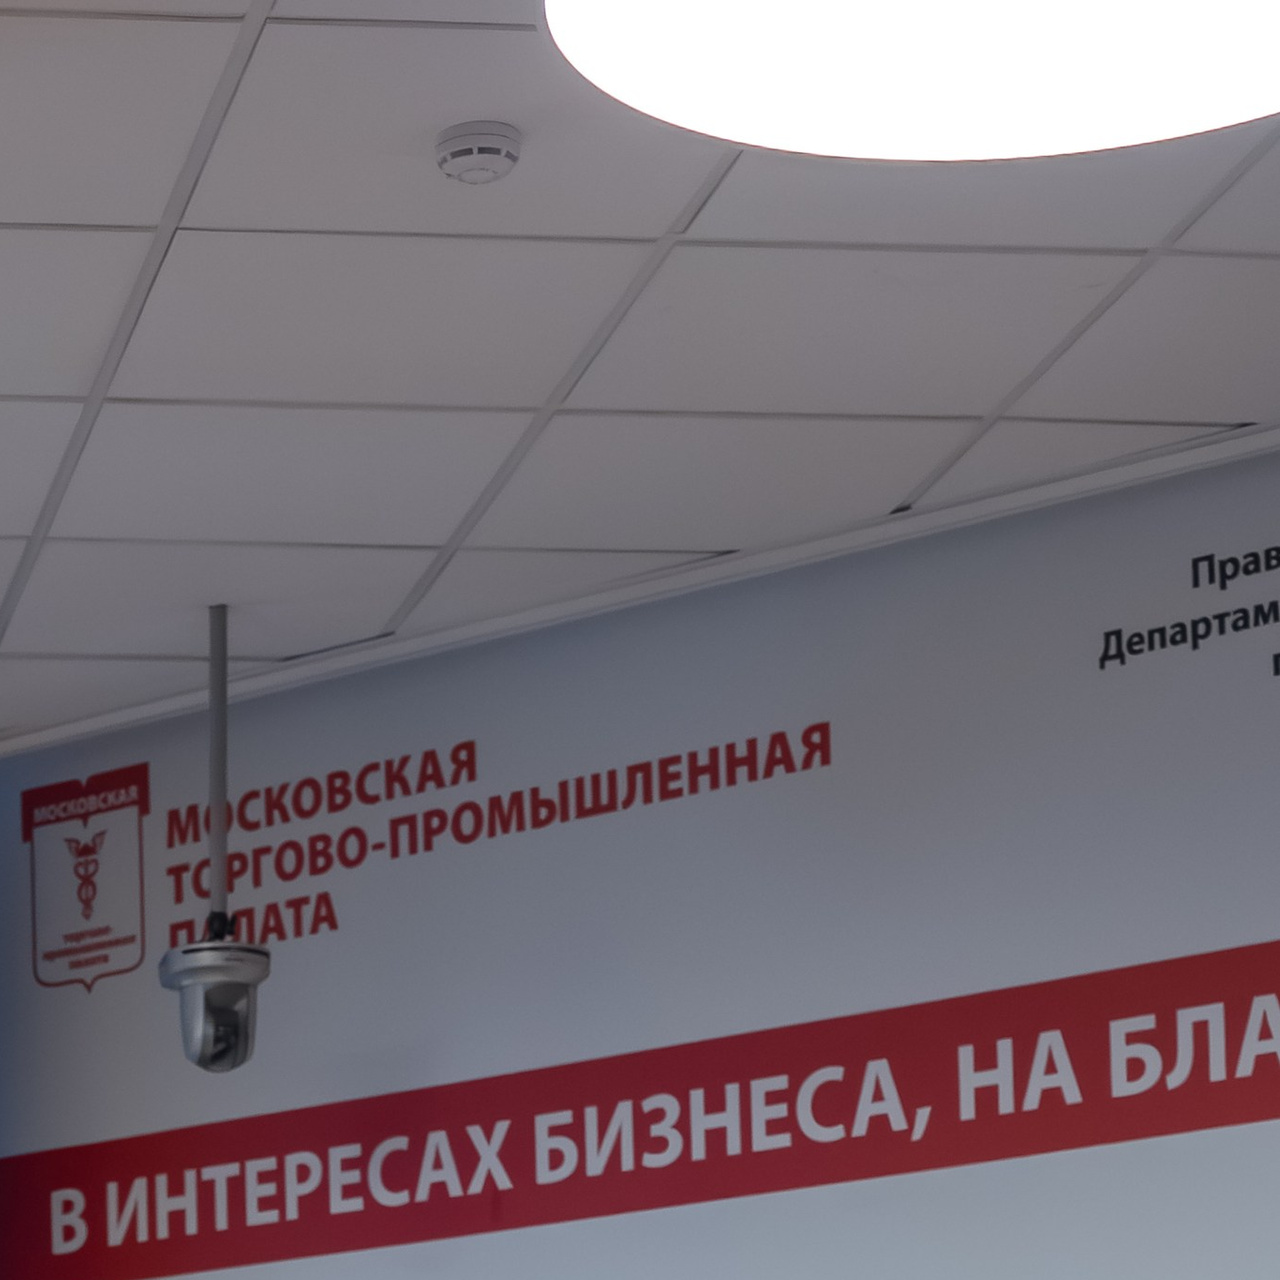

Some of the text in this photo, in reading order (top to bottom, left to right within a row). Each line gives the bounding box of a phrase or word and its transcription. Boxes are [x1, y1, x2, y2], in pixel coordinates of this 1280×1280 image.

[1191, 546, 1280, 591] Прав
[1099, 601, 1280, 670] Департам
[166, 722, 832, 905] ТОРГОВО-ПРОМЫШЛЕННАЯ
[169, 891, 339, 948] ПЛАТА
[49, 993, 1280, 1256] В ИНТЕРЕСАХ БИЗНЕСА, НА БЛА
